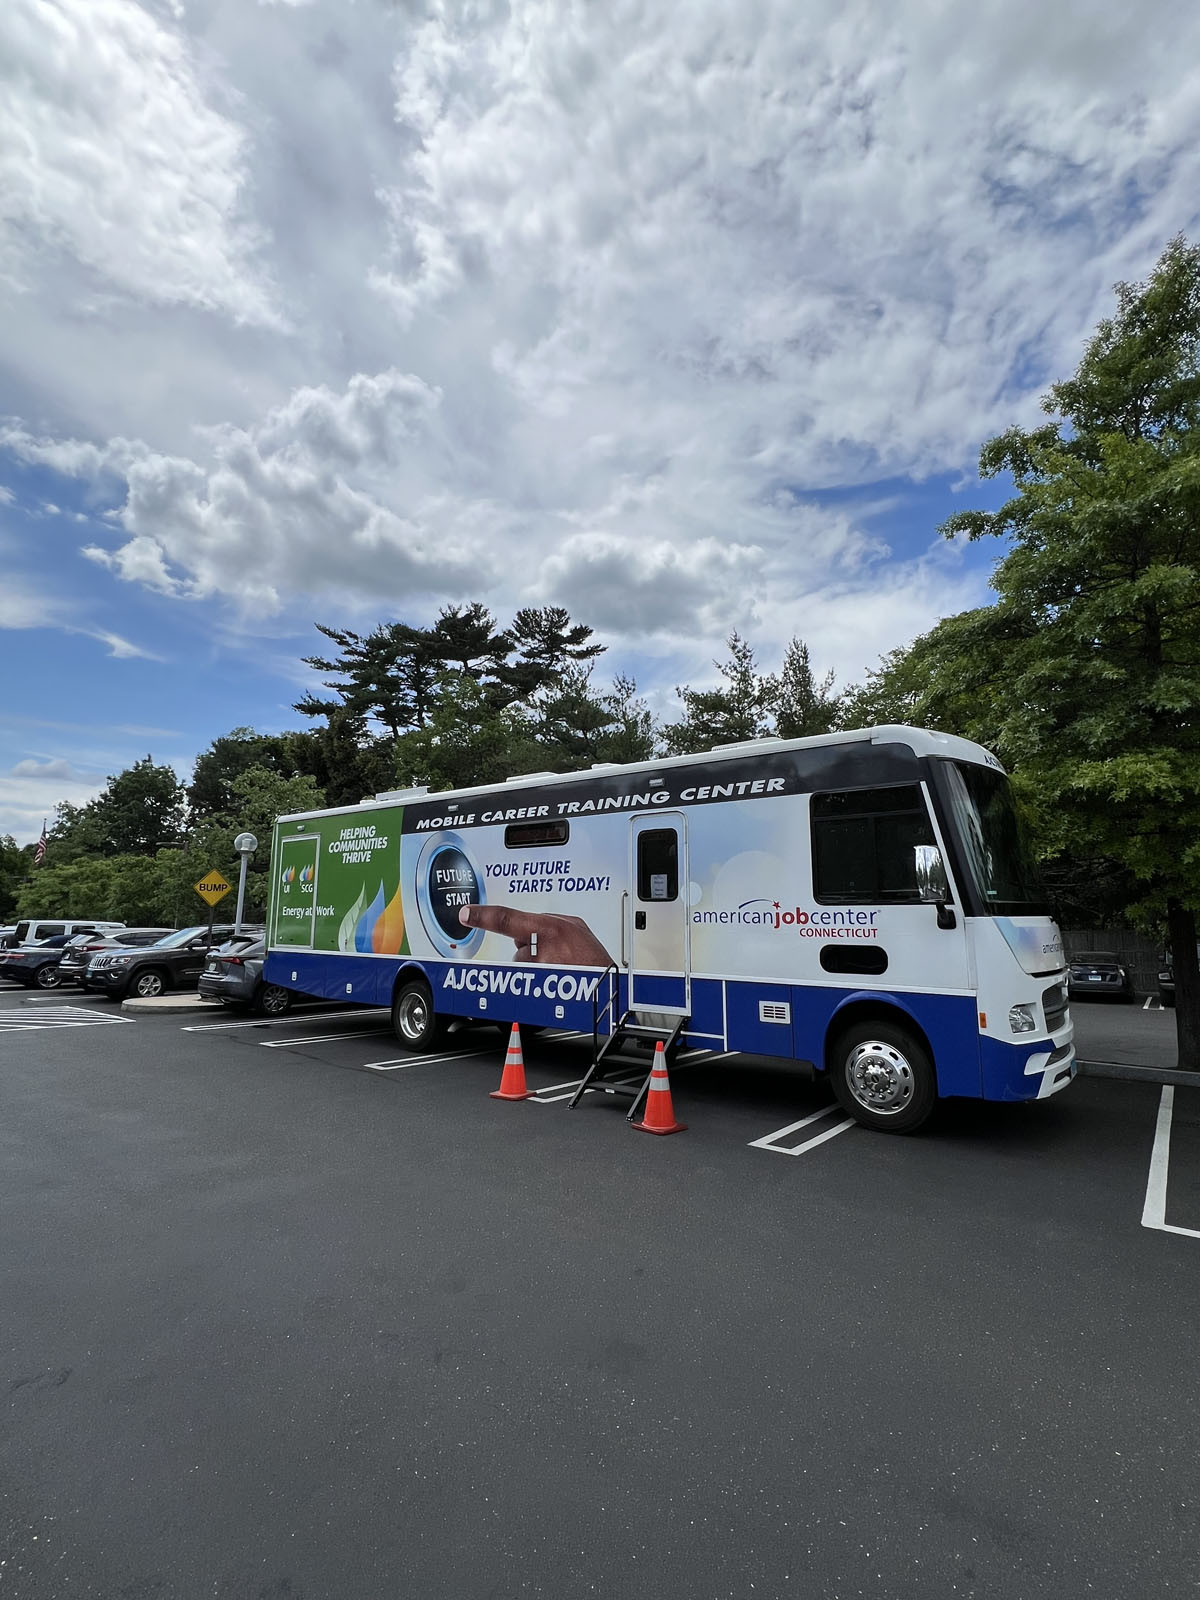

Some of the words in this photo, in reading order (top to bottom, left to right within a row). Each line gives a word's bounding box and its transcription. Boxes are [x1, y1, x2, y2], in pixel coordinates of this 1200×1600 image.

[416, 813, 475, 830] MOBILE
[481, 805, 549, 823] CAREER
[557, 791, 671, 814] TRAINING
[680, 778, 786, 800] CENTER
[340, 825, 376, 837] HELPING
[328, 837, 388, 853] COMMUNITIES
[342, 851, 371, 864] THRIVE
[485, 863, 518, 877] YOUR
[522, 860, 571, 875] FUTURE
[436, 869, 473, 884] FUTURE
[199, 883, 228, 892] BUMP
[283, 884, 290, 893] UI
[301, 884, 313, 893] SCG
[508, 878, 553, 893] STARTS
[558, 877, 610, 892] TODAY!
[446, 893, 471, 907] START
[282, 906, 305, 919] Energy
[305, 907, 313, 916] at
[316, 905, 335, 916] Work
[799, 928, 878, 938] CONNECTICUT
[443, 967, 599, 1002] AJCSWCT.COM
